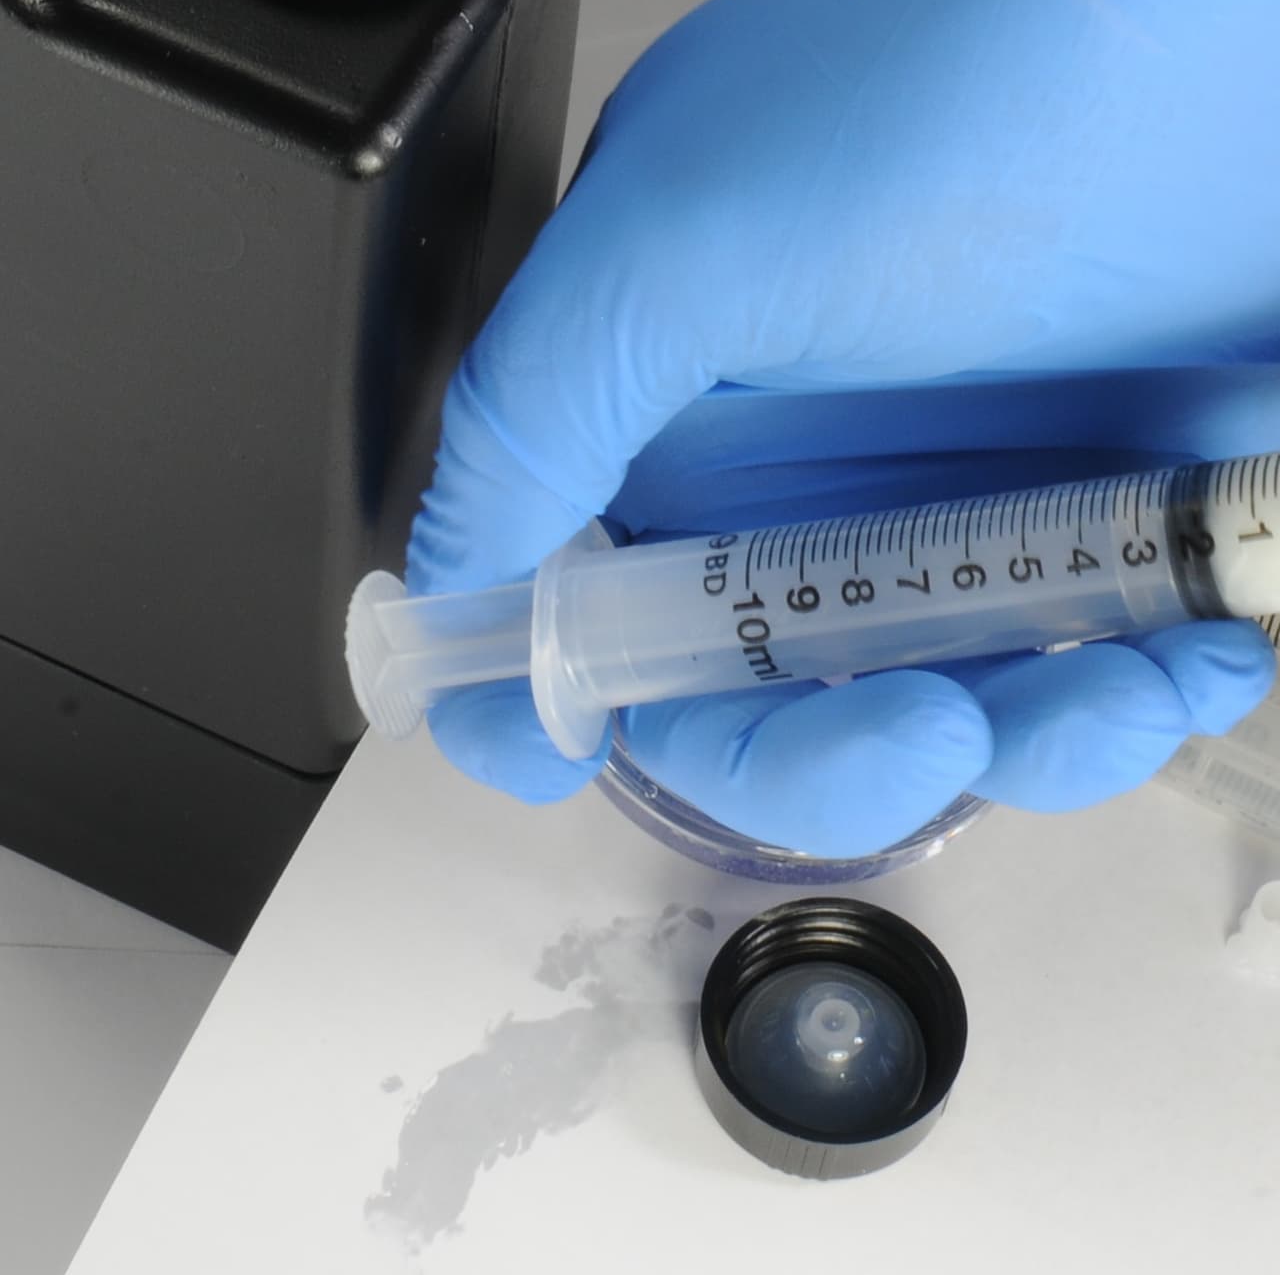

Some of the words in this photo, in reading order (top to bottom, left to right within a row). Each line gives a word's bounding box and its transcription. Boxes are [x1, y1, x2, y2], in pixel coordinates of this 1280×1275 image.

[1179, 530, 1216, 562] 2
[1237, 522, 1274, 543] 1
[1066, 548, 1101, 576] 4
[1122, 539, 1158, 567] 3
[896, 568, 931, 595] 7
[952, 563, 987, 591] 6
[1008, 556, 1045, 584] 5
[786, 585, 821, 614] 9
[841, 578, 876, 607] 8
[733, 591, 793, 682] 10ml
